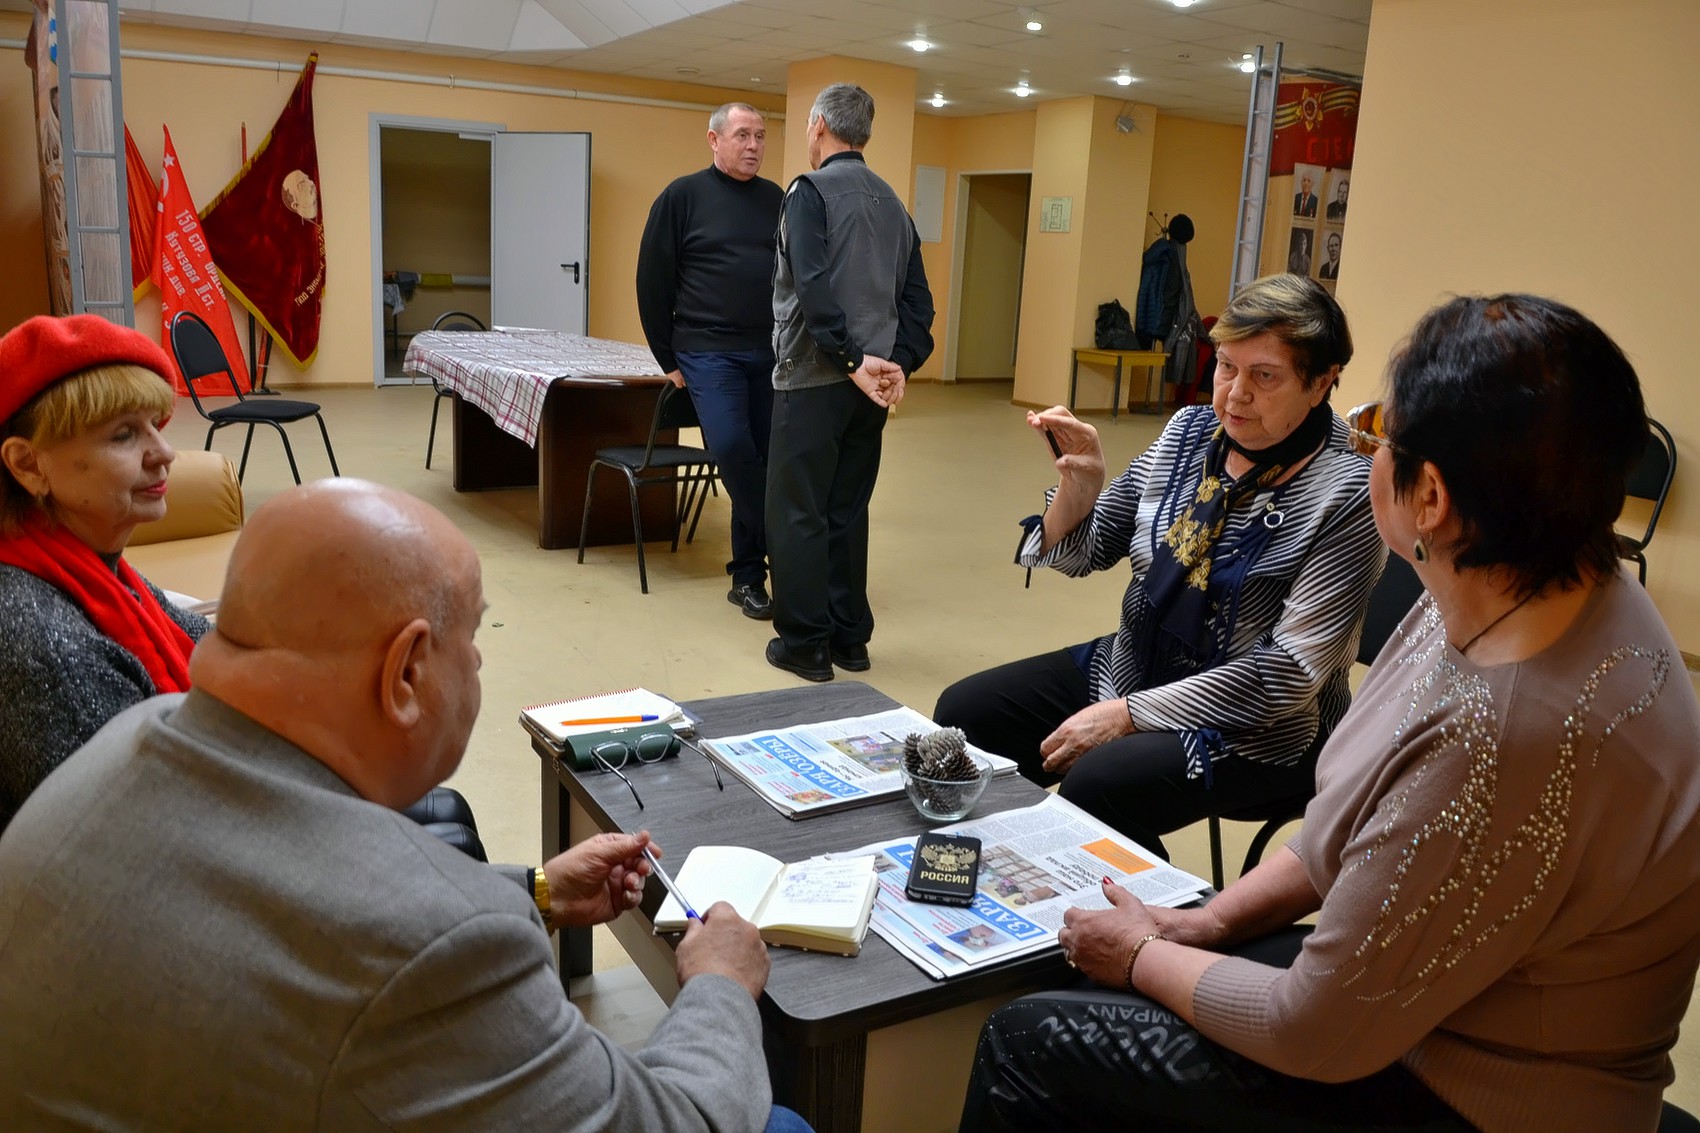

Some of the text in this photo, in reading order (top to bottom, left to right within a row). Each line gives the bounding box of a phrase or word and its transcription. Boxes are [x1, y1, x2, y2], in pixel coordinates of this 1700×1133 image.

[175, 209, 198, 234] 150
[920, 870, 970, 885] РОССИЯ
[1086, 1003, 1187, 1027] OMPANY
